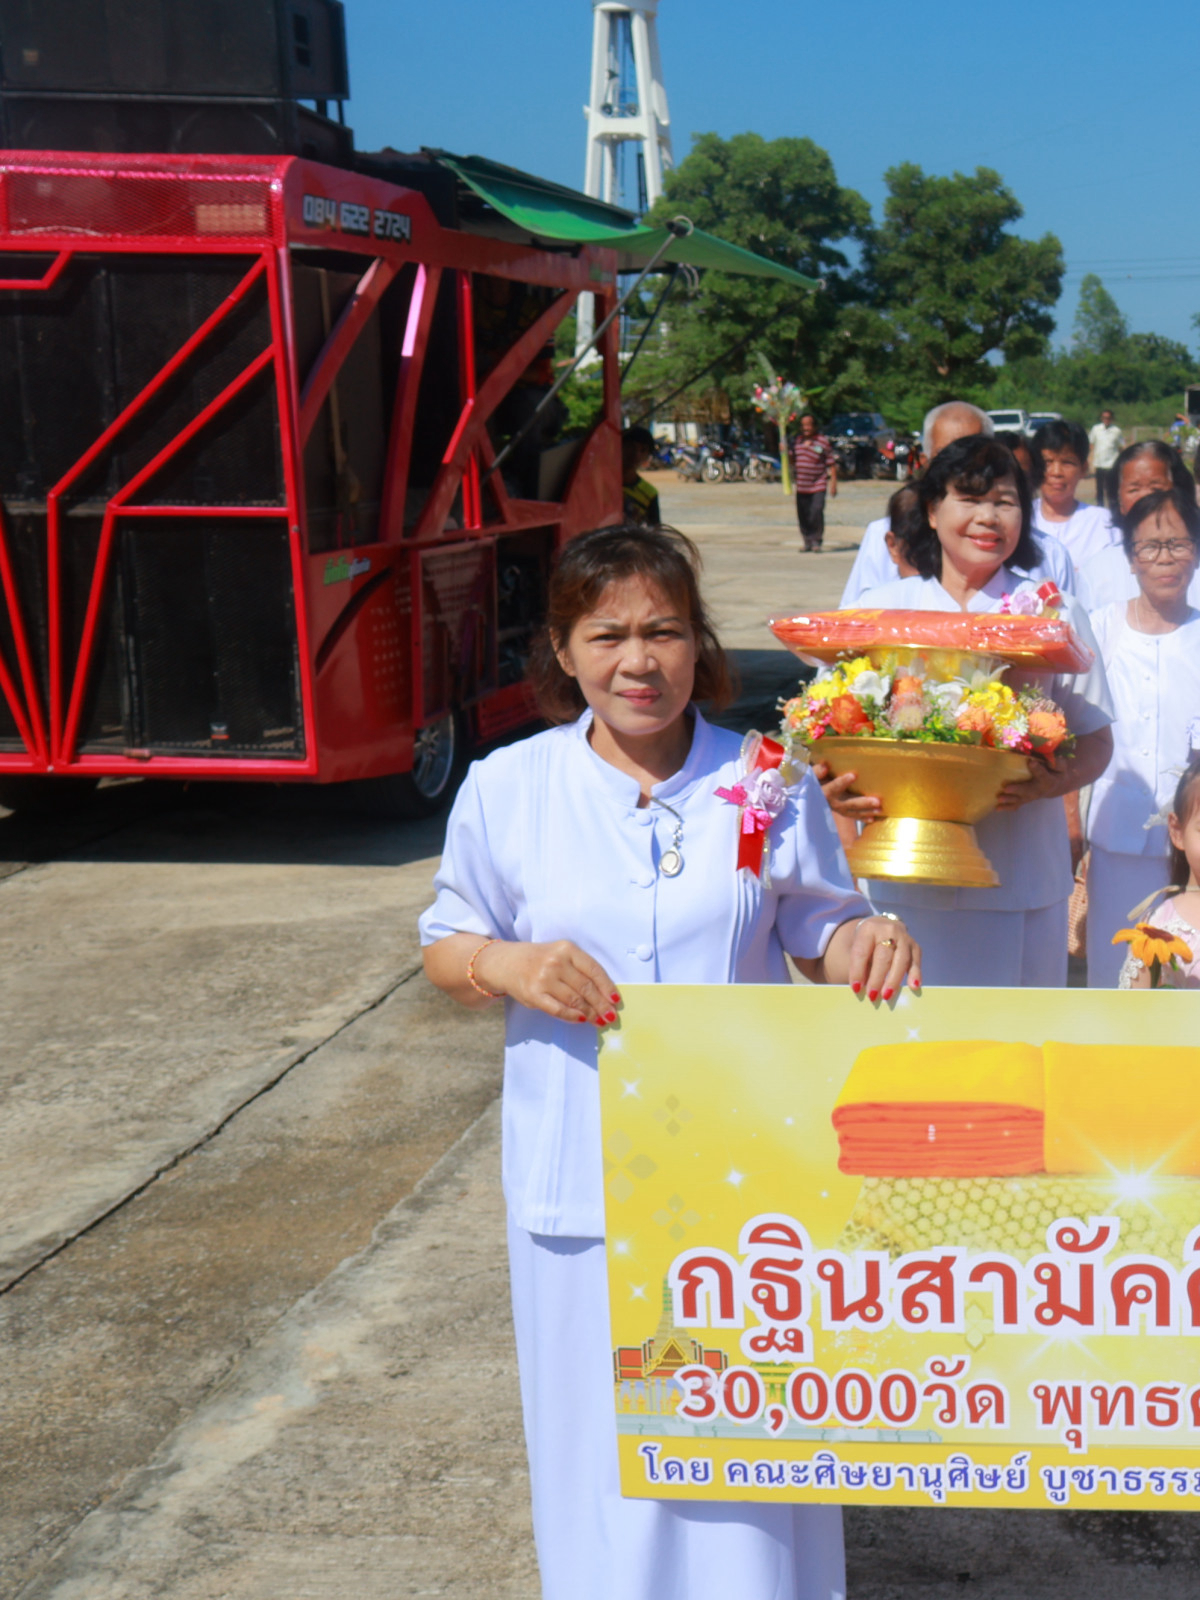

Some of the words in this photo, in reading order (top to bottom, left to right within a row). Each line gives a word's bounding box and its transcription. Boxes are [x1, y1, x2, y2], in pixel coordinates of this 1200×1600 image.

[303, 194, 337, 228] 084
[340, 202, 370, 233] 622
[373, 208, 411, 242] 2724
[641, 1444, 711, 1483] โดย
[726, 1452, 1028, 1501] คณะศิษยานุศิษย์
